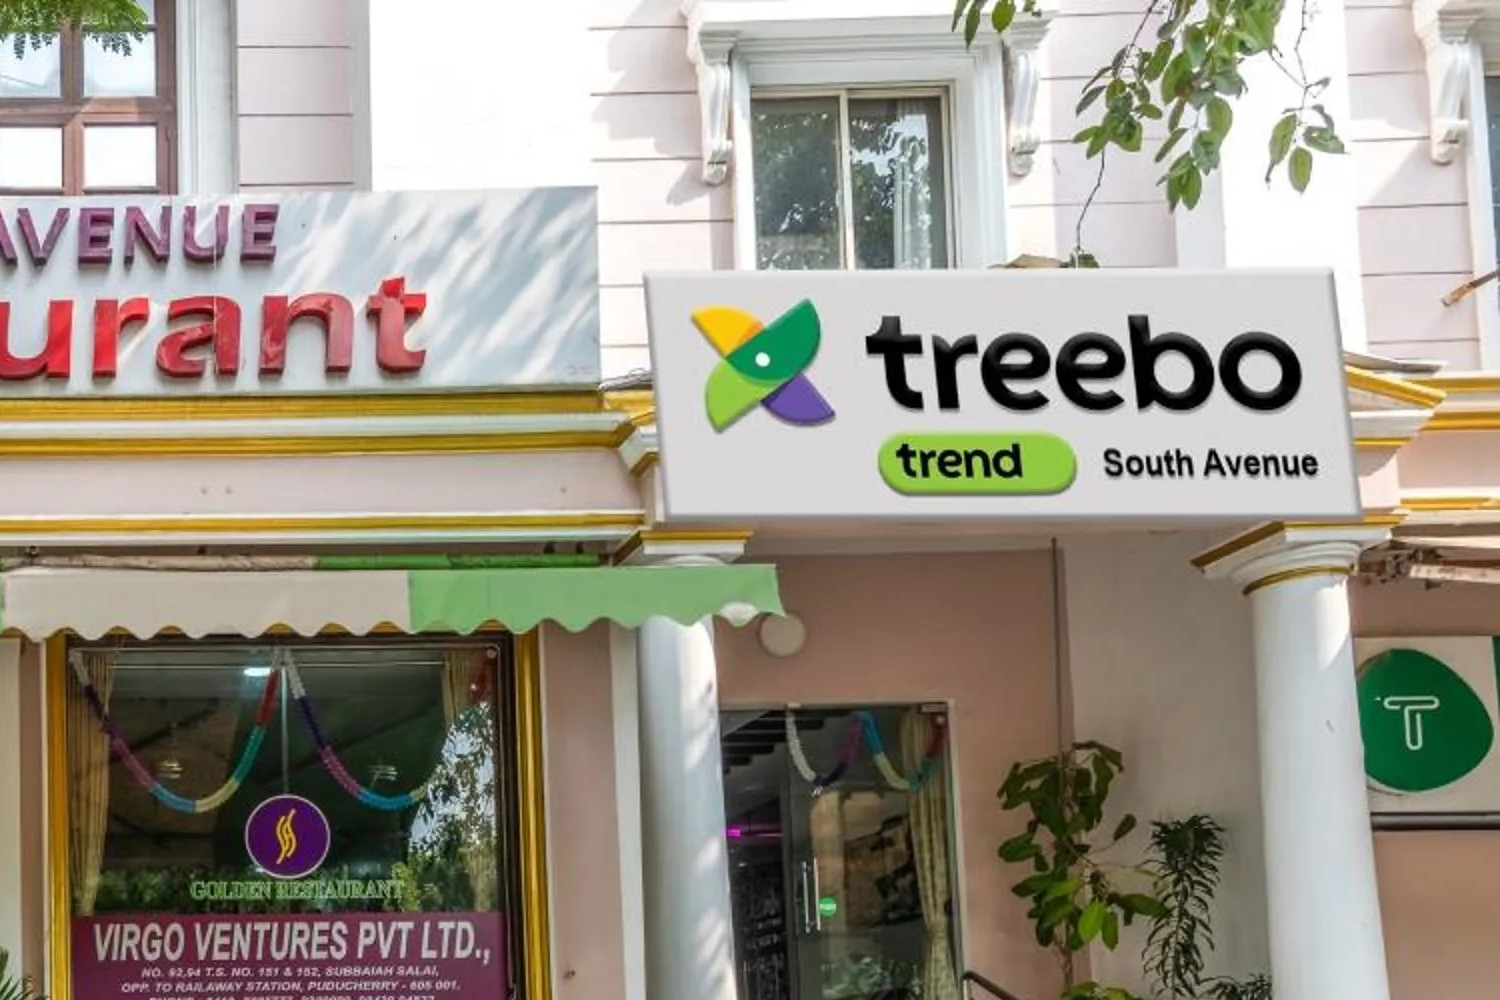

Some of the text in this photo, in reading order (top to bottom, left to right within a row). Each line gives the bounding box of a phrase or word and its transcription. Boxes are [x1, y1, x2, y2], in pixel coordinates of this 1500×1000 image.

[864, 313, 1302, 413] treebo
[895, 441, 1024, 479] trend
[1102, 446, 1319, 478] South Avenue
[1383, 696, 1440, 750] T
[191, 879, 403, 899] GOLDEN RESTAURANT
[93, 920, 491, 964] VIRGO VENTURES PVT LTD.,
[141, 967, 164, 978] NO.
[231, 967, 254, 977] NO.
[283, 967, 292, 977] &
[156, 982, 172, 992] TO
[245, 981, 303, 992] STATION,
[307, 981, 399, 991] PUDUCHERRY
